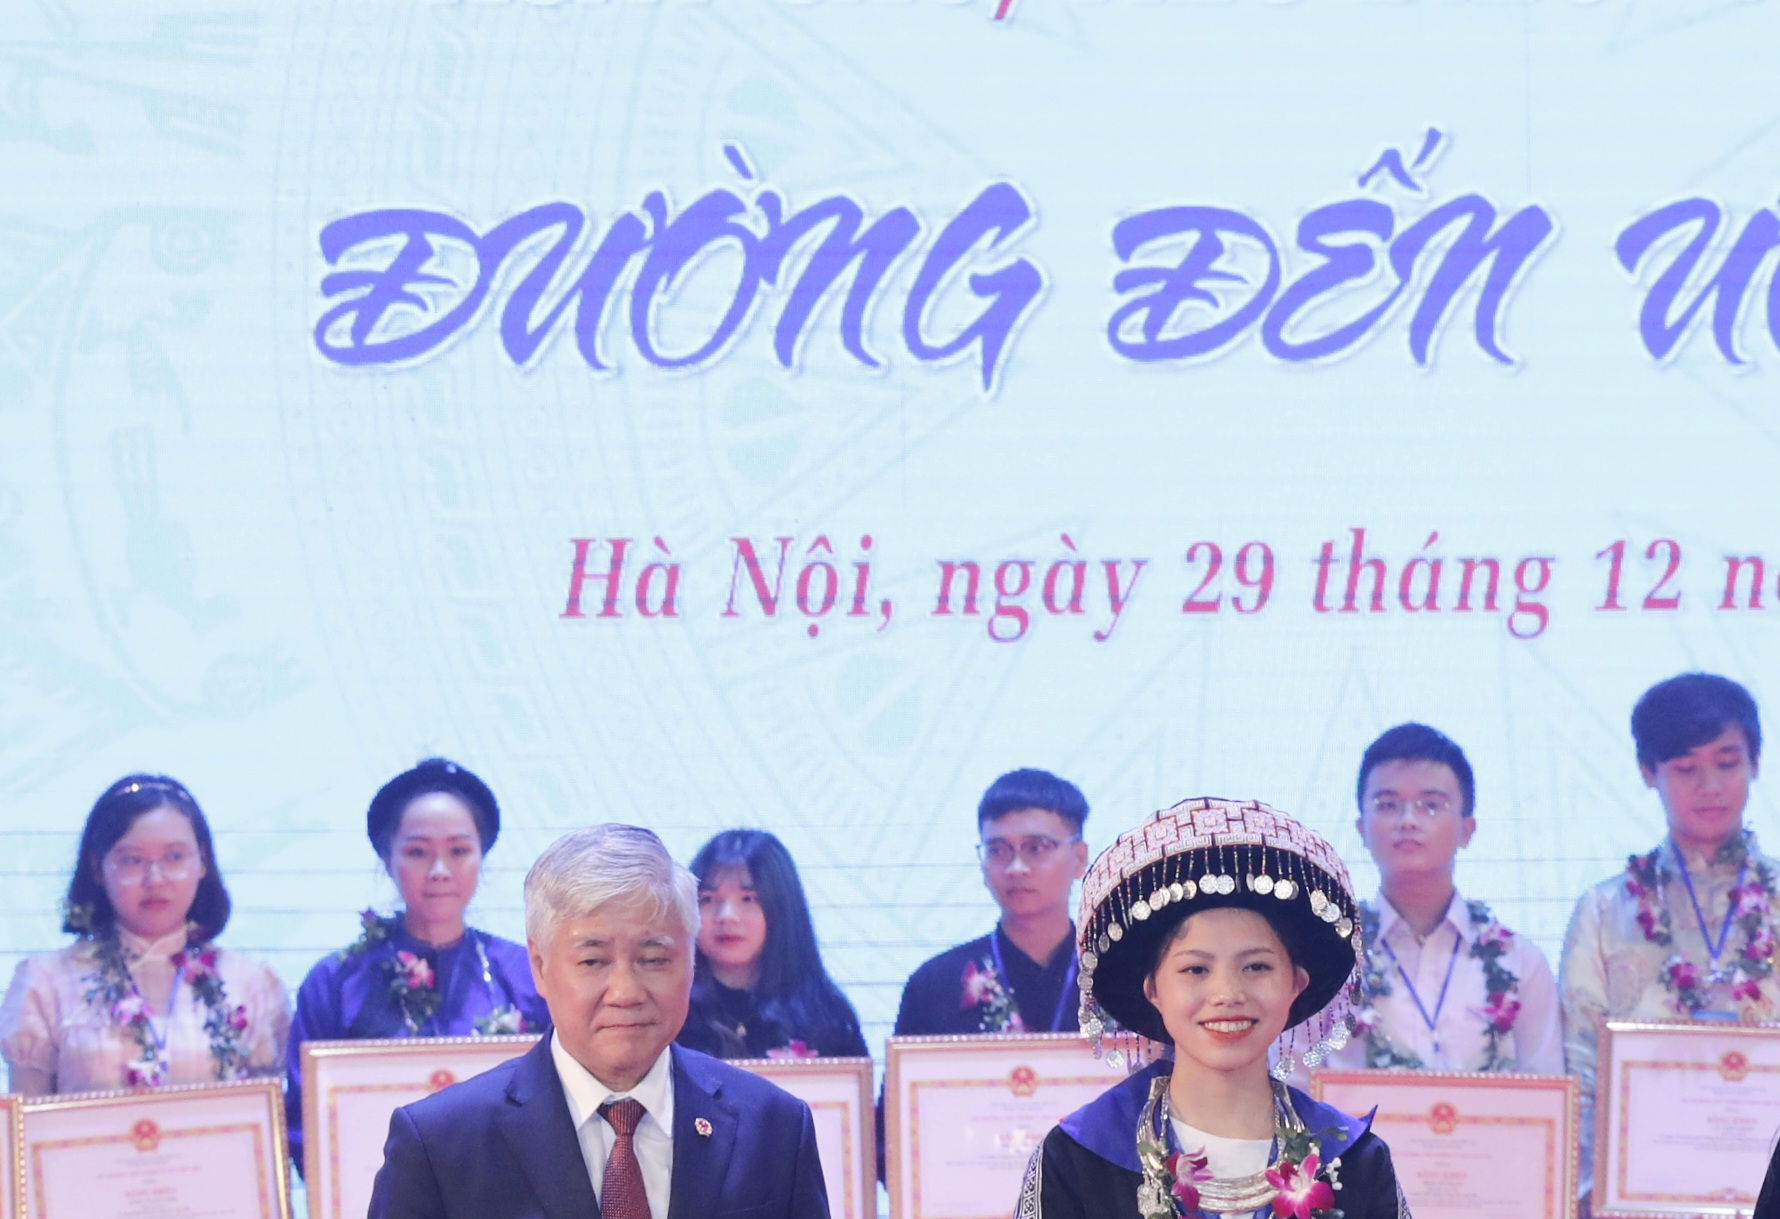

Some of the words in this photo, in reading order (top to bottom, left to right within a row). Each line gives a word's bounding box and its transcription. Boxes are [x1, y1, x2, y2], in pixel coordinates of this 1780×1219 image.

[312, 144, 1043, 392] ĐƯỜNG
[1107, 126, 1553, 366] ĐẾN
[559, 535, 683, 619] Hà
[721, 535, 895, 639] Nội,
[932, 533, 1150, 644] ngày
[1181, 541, 1276, 615] 29
[1311, 528, 1558, 641] tháng
[1594, 538, 1684, 612] 12
